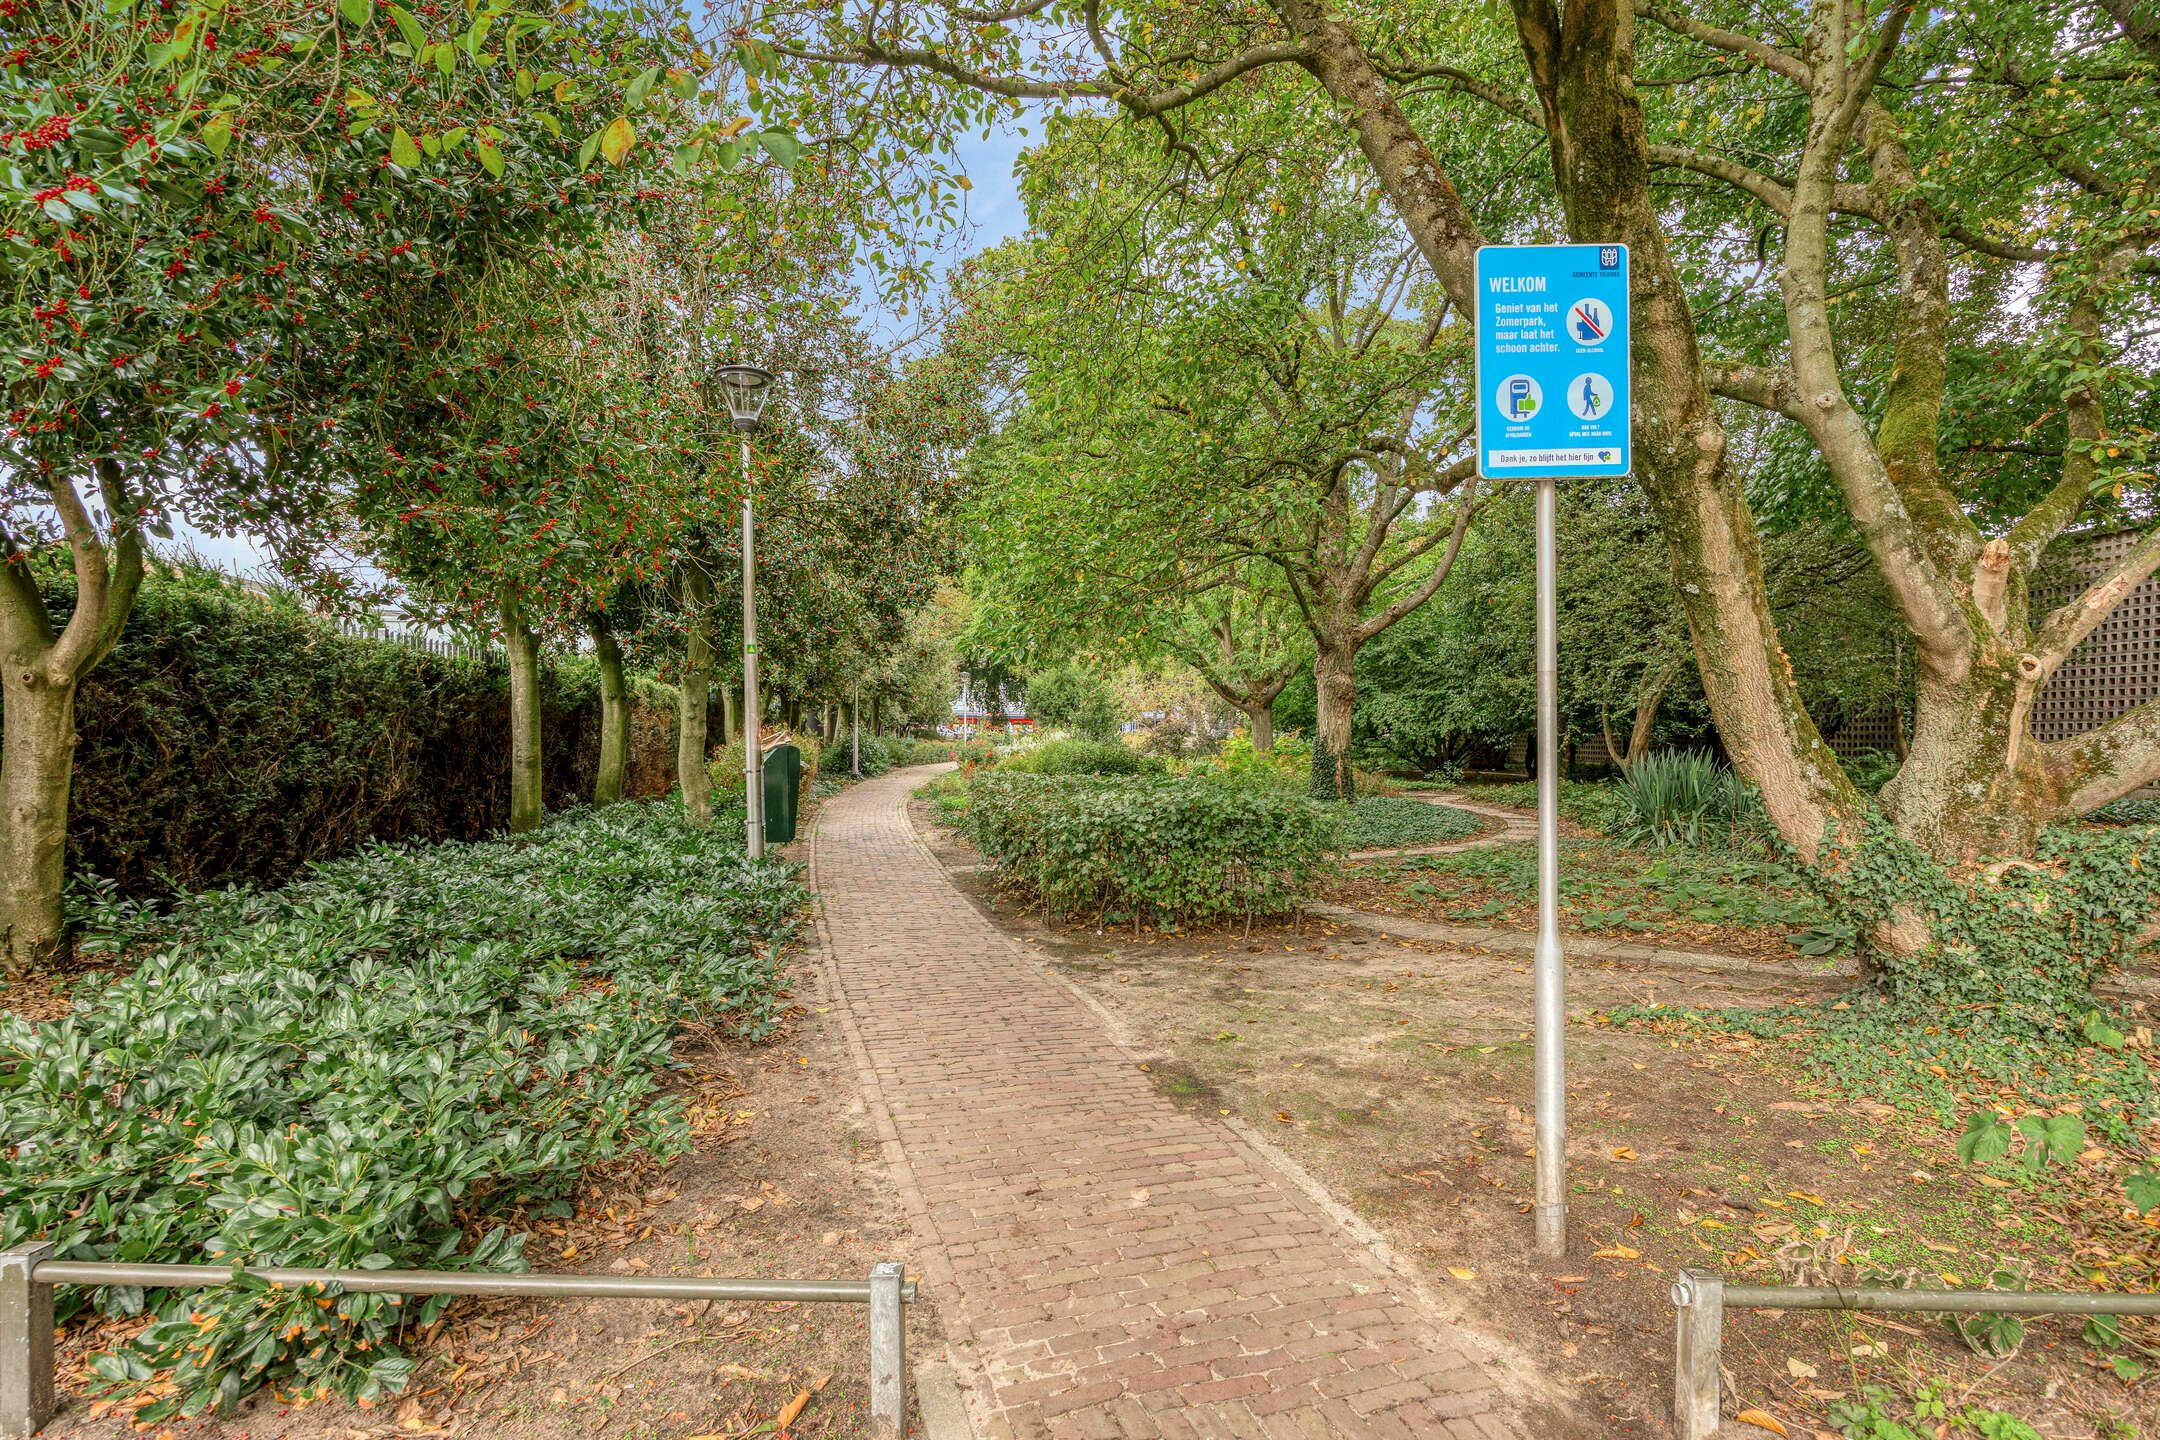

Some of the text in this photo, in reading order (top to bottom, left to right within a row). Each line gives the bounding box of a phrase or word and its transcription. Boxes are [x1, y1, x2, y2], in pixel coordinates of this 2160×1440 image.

[1489, 276, 1546, 293] WELKOM
[1495, 302, 1558, 313] Geniet van het
[1495, 316, 1546, 328] Zomerpark,
[1496, 329, 1554, 340] maar laat het
[1496, 343, 1560, 353] schoon achter.
[1500, 454, 1517, 463] Dank
[1518, 455, 1528, 464] je,
[1538, 453, 1554, 463] blijft
[1555, 453, 1567, 461] het
[1568, 453, 1581, 461] hier
[1583, 452, 1594, 462] fijn
